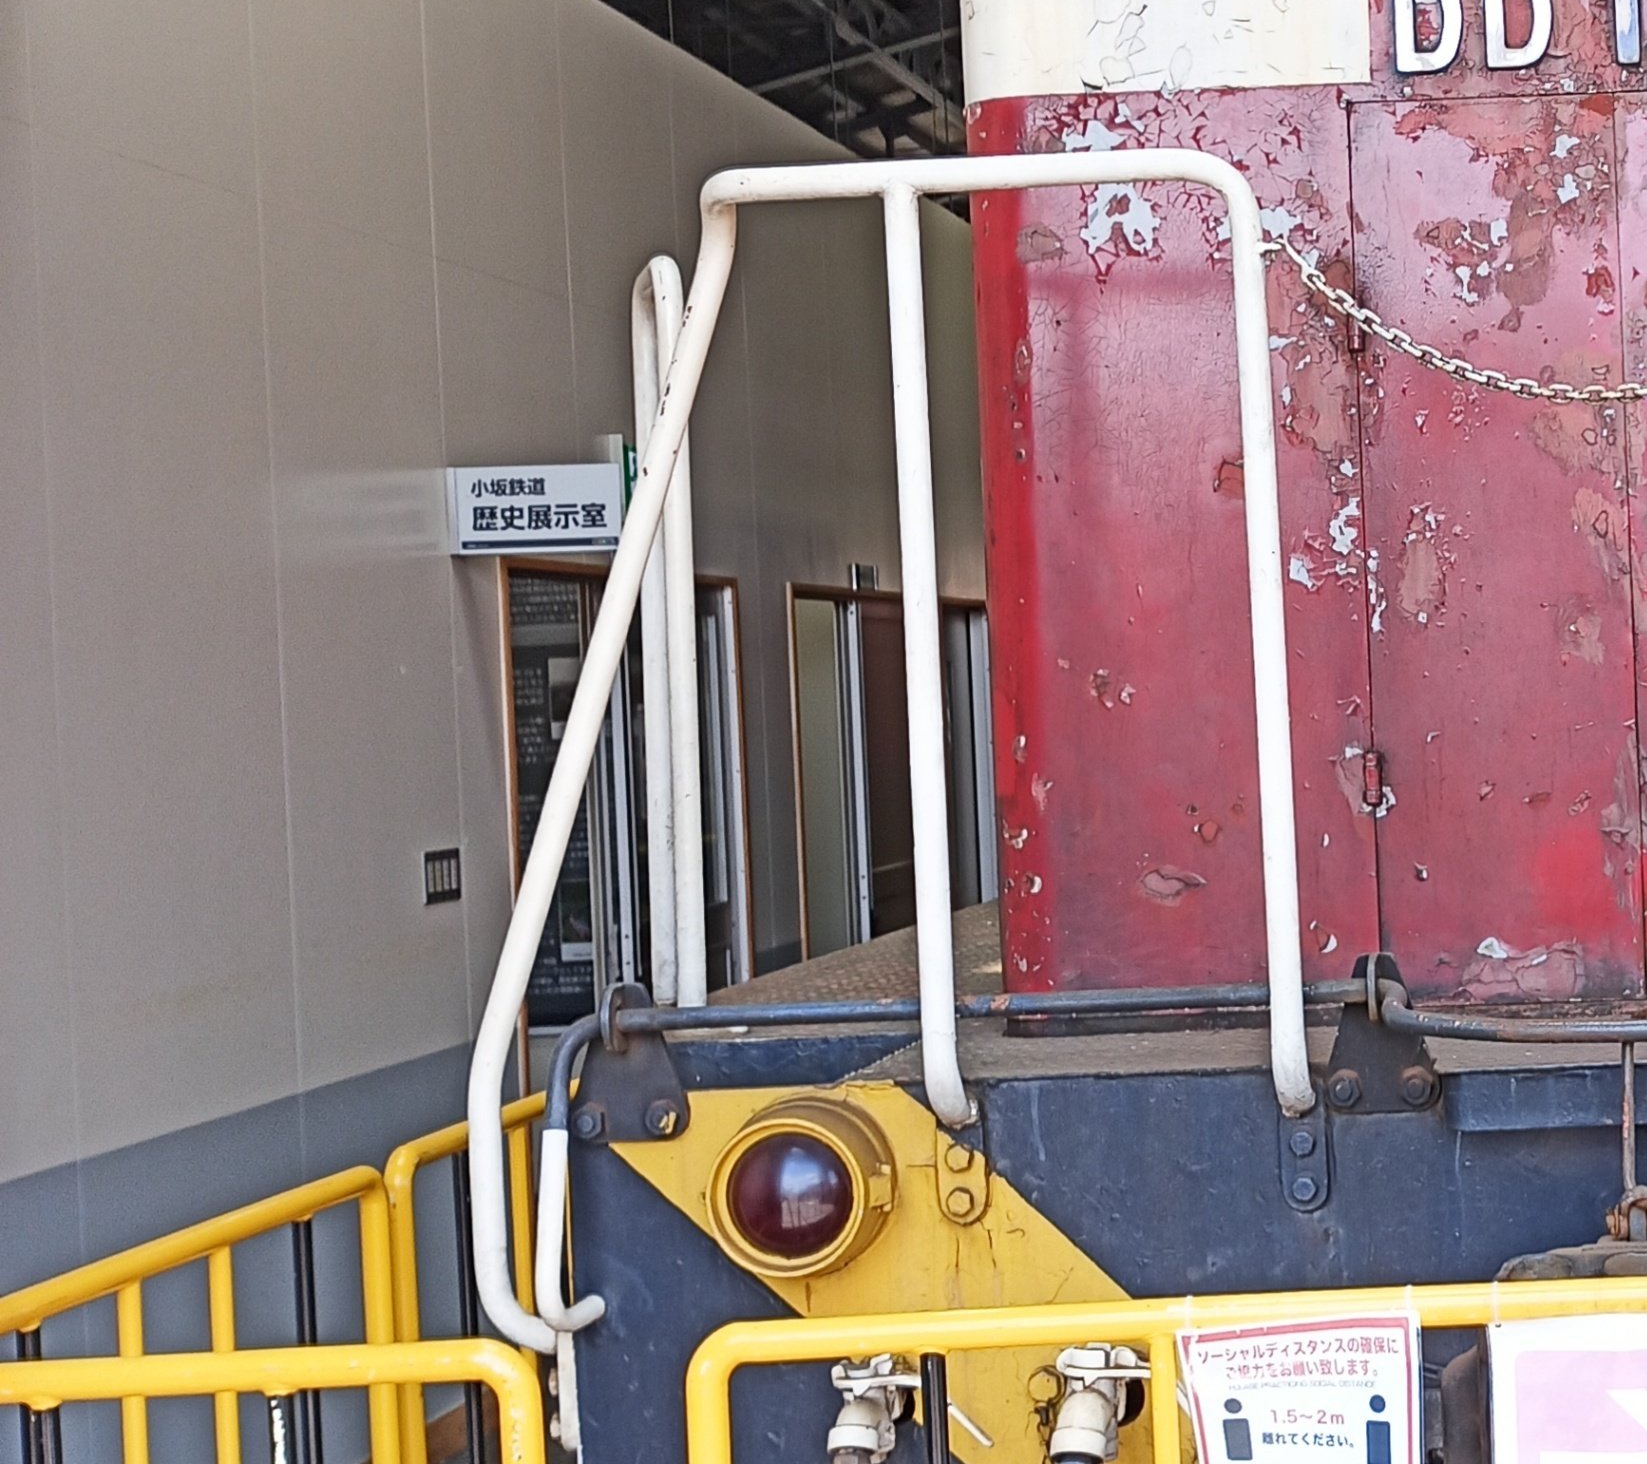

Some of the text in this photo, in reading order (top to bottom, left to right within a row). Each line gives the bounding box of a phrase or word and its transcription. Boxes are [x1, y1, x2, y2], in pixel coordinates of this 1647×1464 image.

[471, 477, 546, 498] 小坂鉄道
[472, 502, 608, 531] 歴史展示室
[1197, 1336, 1399, 1364] ソーシャルディスタンスの確保に
[1262, 1432, 1354, 1448] 離れてください。
